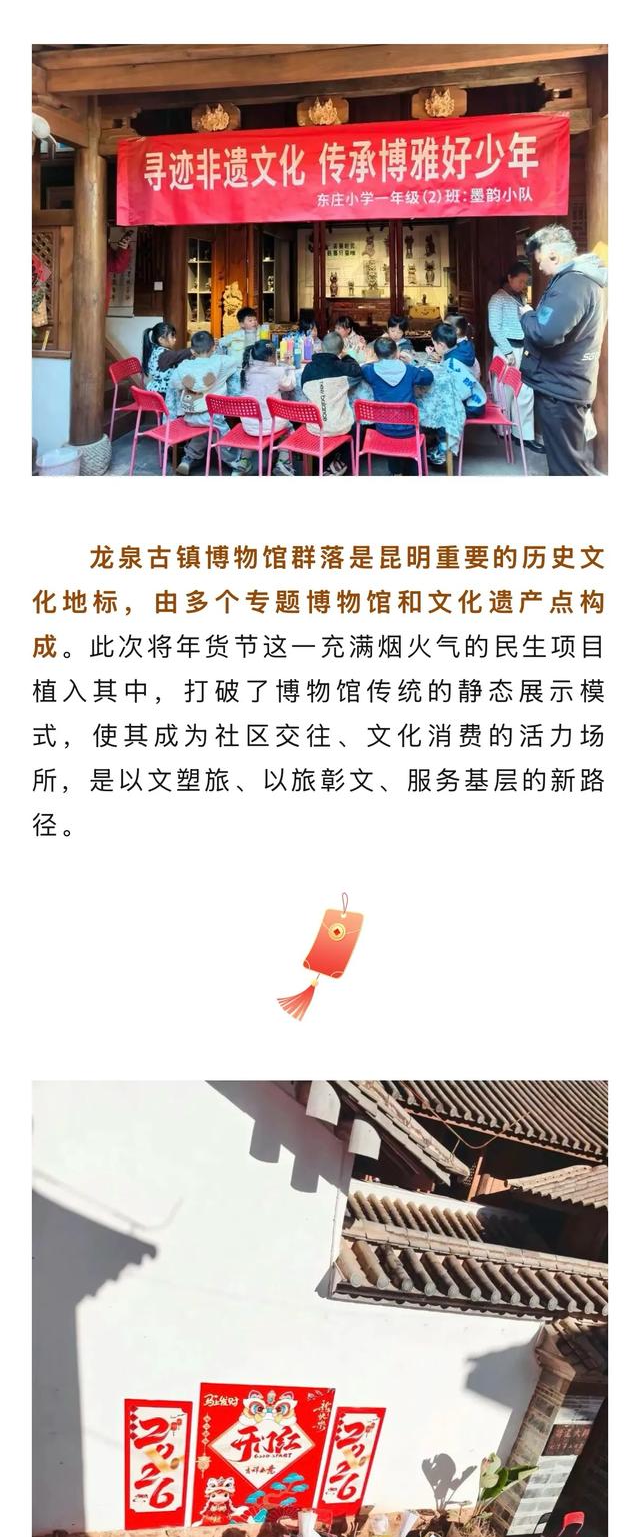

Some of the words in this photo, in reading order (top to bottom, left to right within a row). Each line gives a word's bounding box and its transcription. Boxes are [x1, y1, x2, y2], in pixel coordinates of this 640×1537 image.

[143, 143, 305, 192] 寻迹非遗文化
[318, 131, 539, 185] 传承博雅好少年
[133, 1417, 175, 1509] 2026
[230, 1425, 302, 1463] 开门红
[329, 1421, 365, 1500] 2026
